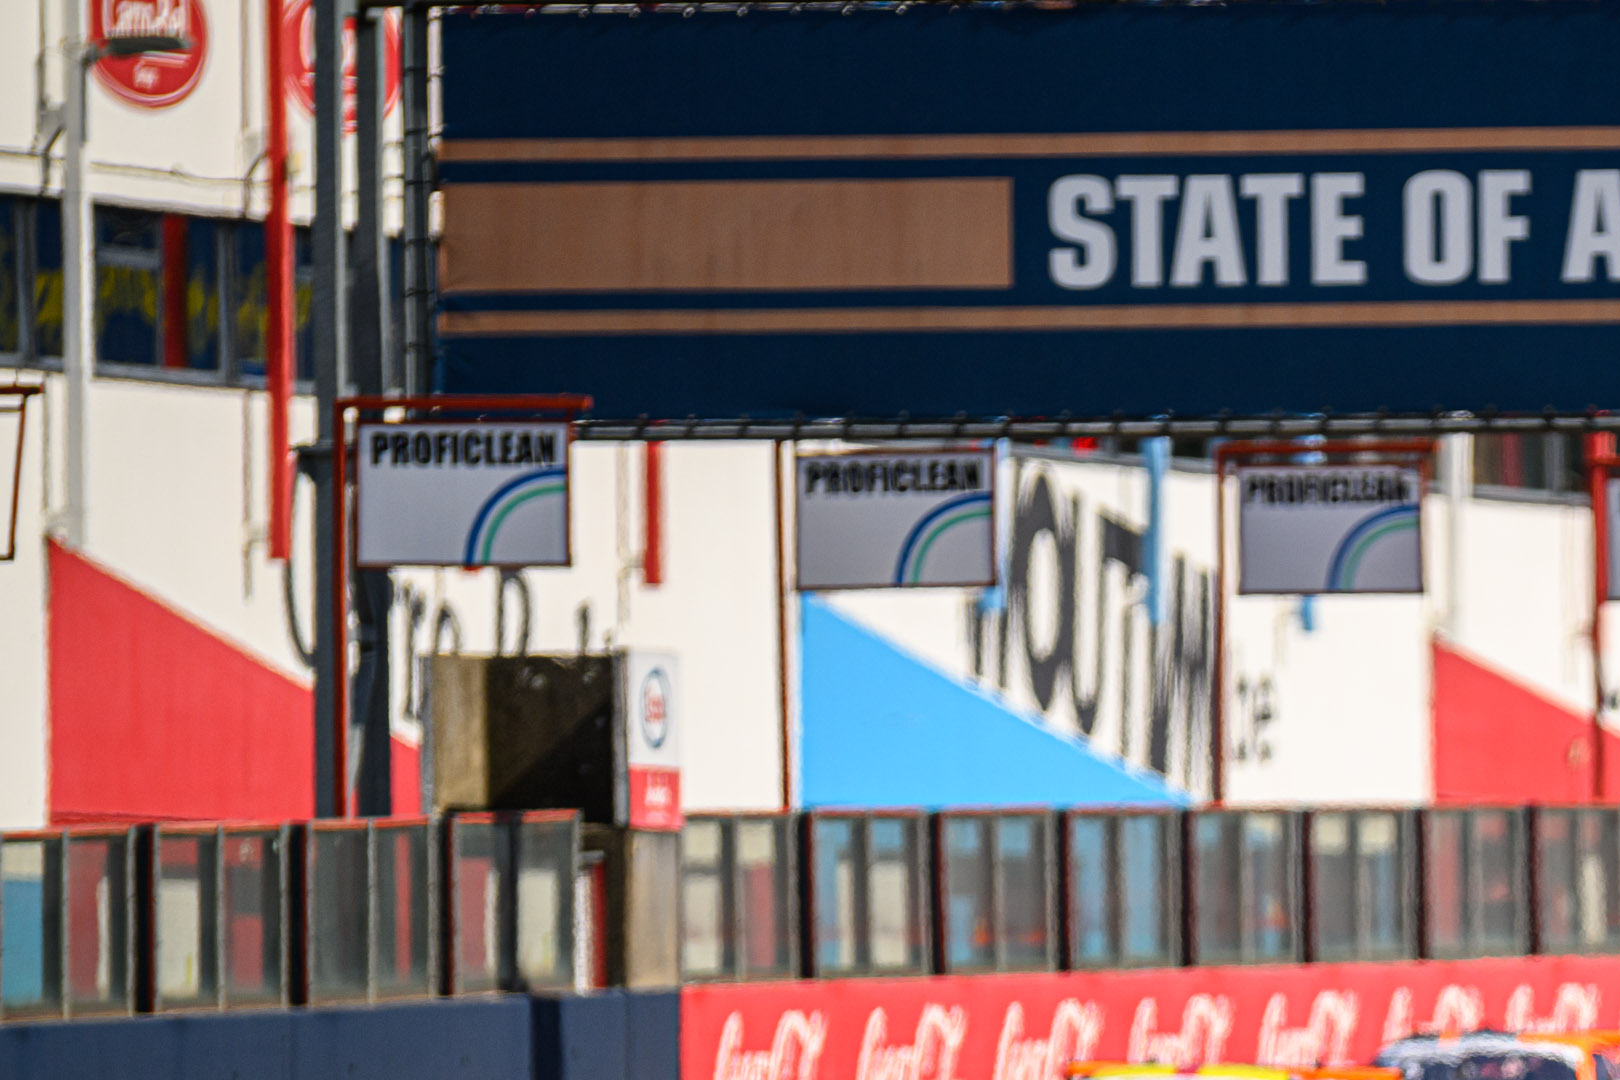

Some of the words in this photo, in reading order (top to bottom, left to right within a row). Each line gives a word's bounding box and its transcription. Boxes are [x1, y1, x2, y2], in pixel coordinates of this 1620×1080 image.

[1047, 172, 1367, 290] STATE
[1402, 169, 1531, 284] OF
[370, 430, 557, 468] PROFICLEAN
[805, 460, 982, 495] PROFICLEAN
[1245, 473, 1411, 508] PROFICLEAN
